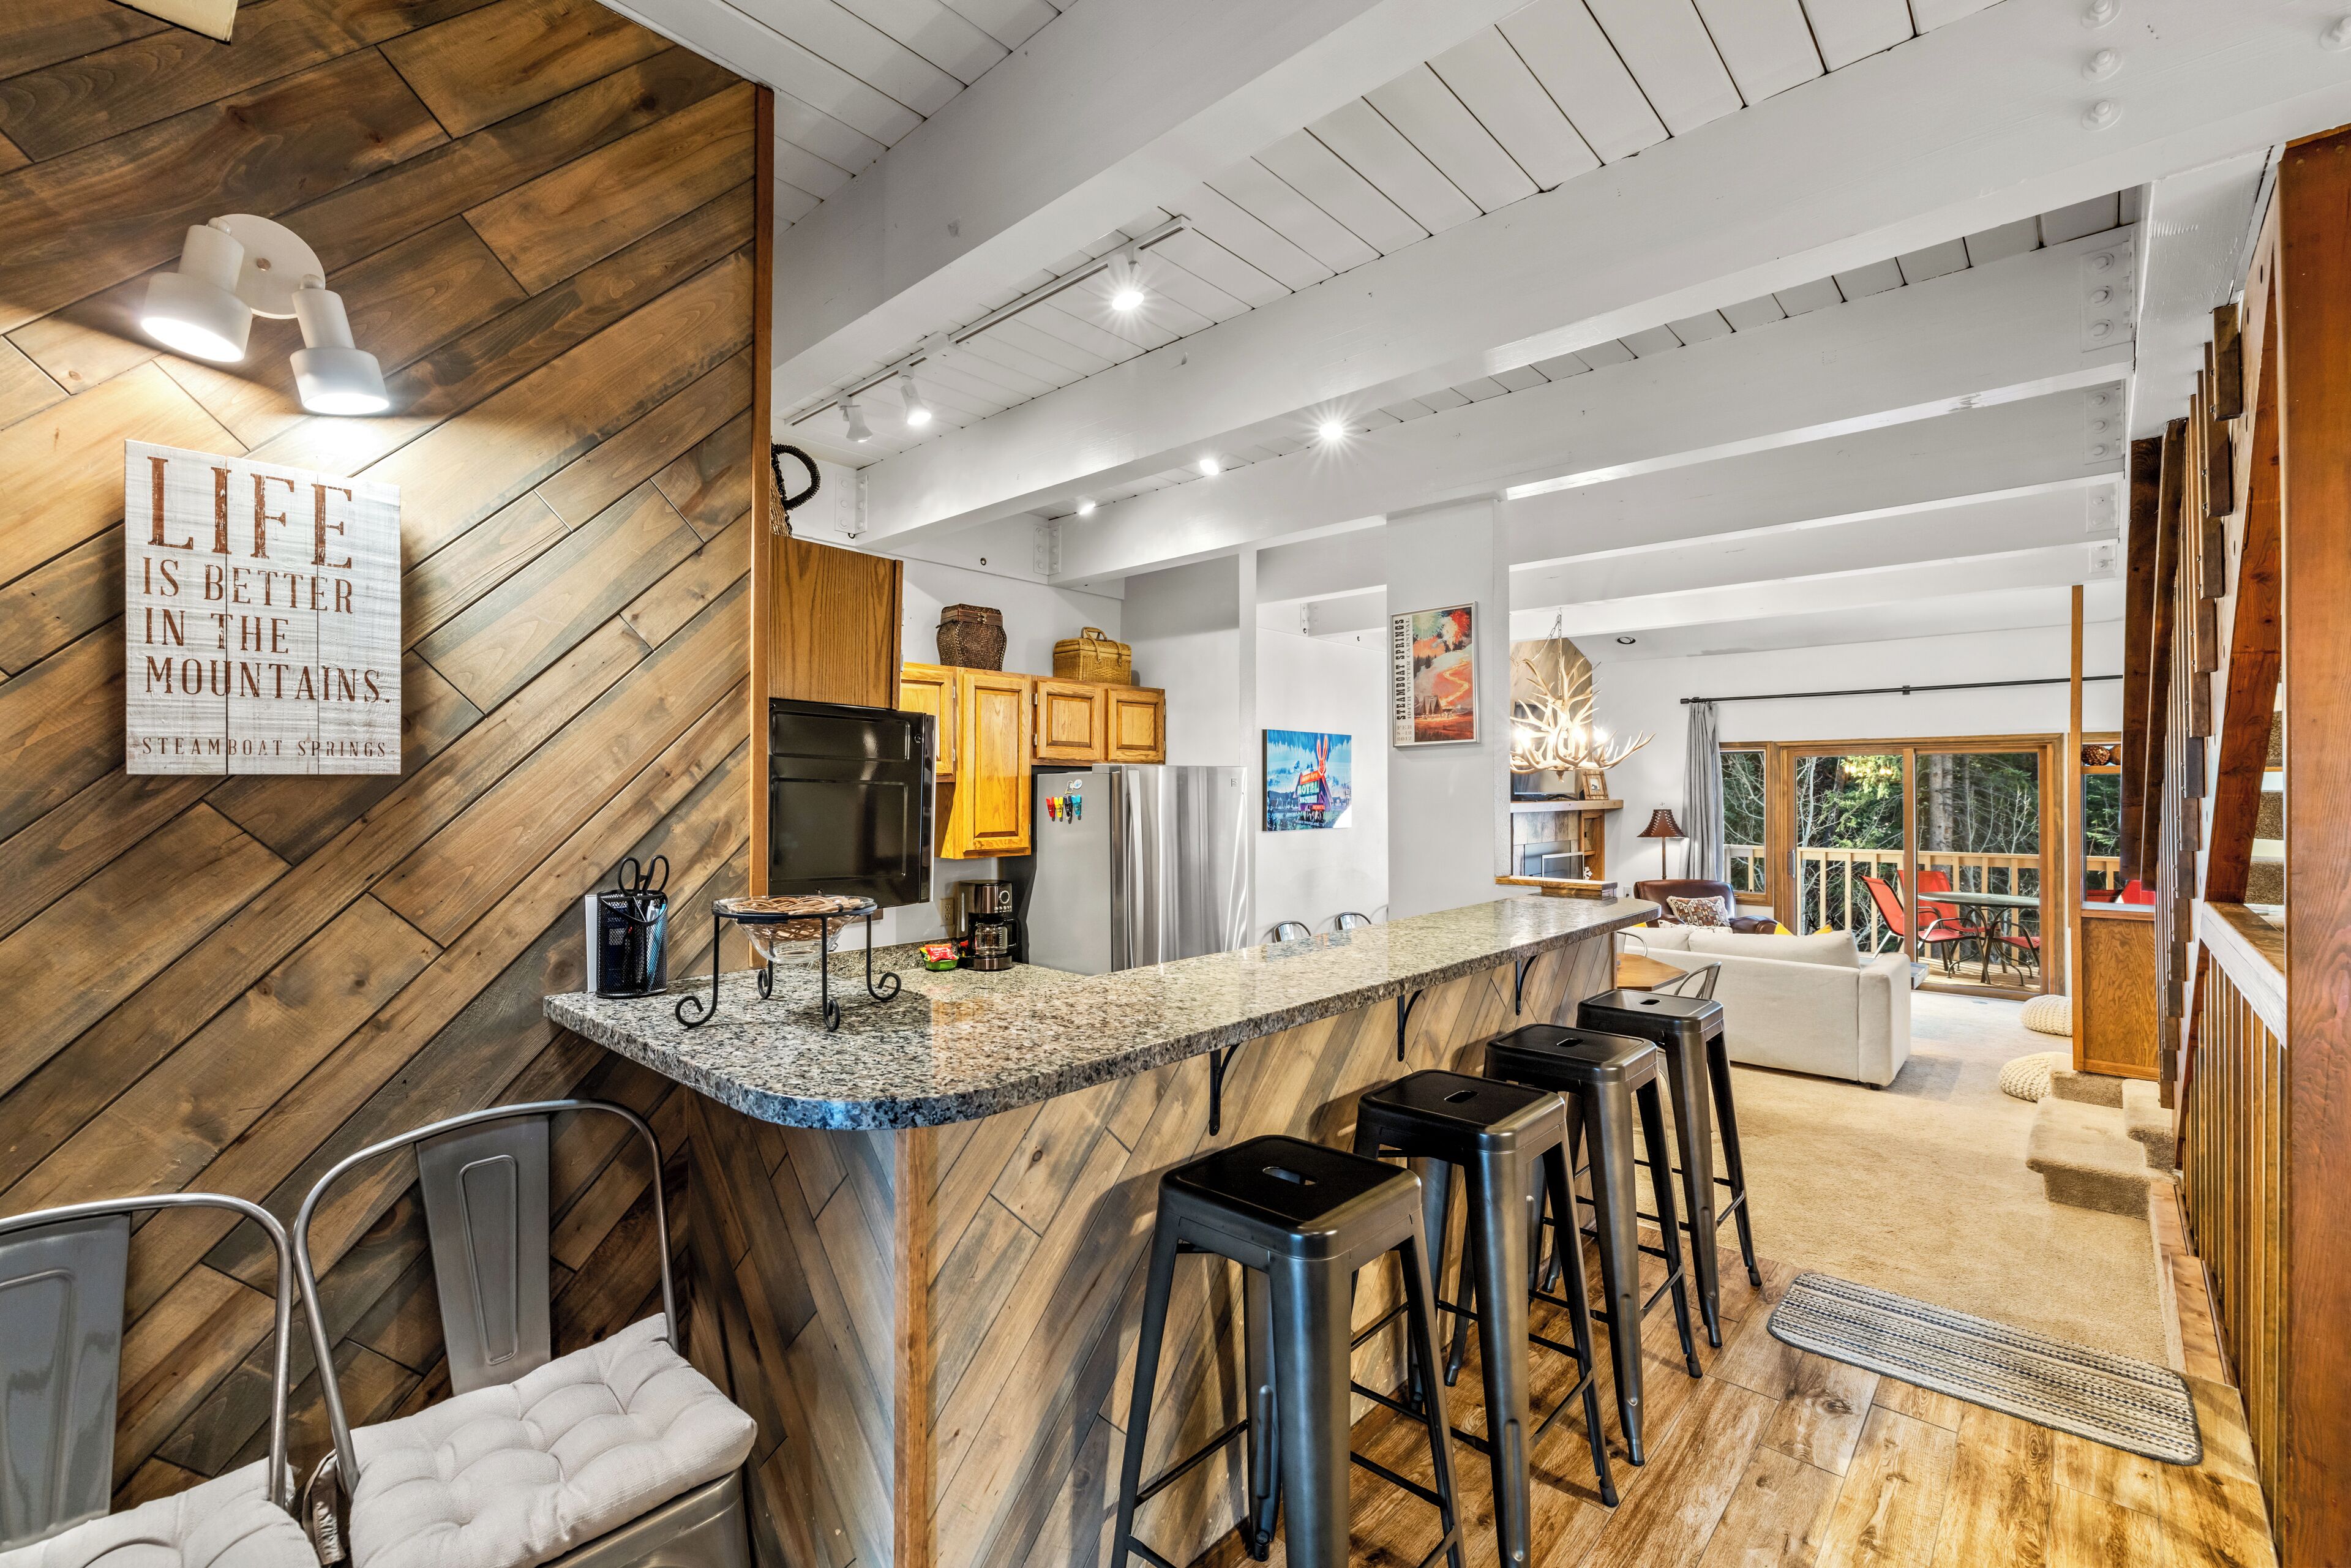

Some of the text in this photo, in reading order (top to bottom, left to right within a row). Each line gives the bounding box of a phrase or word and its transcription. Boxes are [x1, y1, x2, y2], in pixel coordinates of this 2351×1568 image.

[147, 456, 353, 569] LIFE
[143, 557, 353, 614] IS BETTER
[144, 607, 289, 654] IN THE
[145, 656, 391, 703] MOUNTAINS.
[1395, 619, 1406, 720] STEAMBOAT SPRINGS
[143, 737, 282, 757] STEAMBOAT
